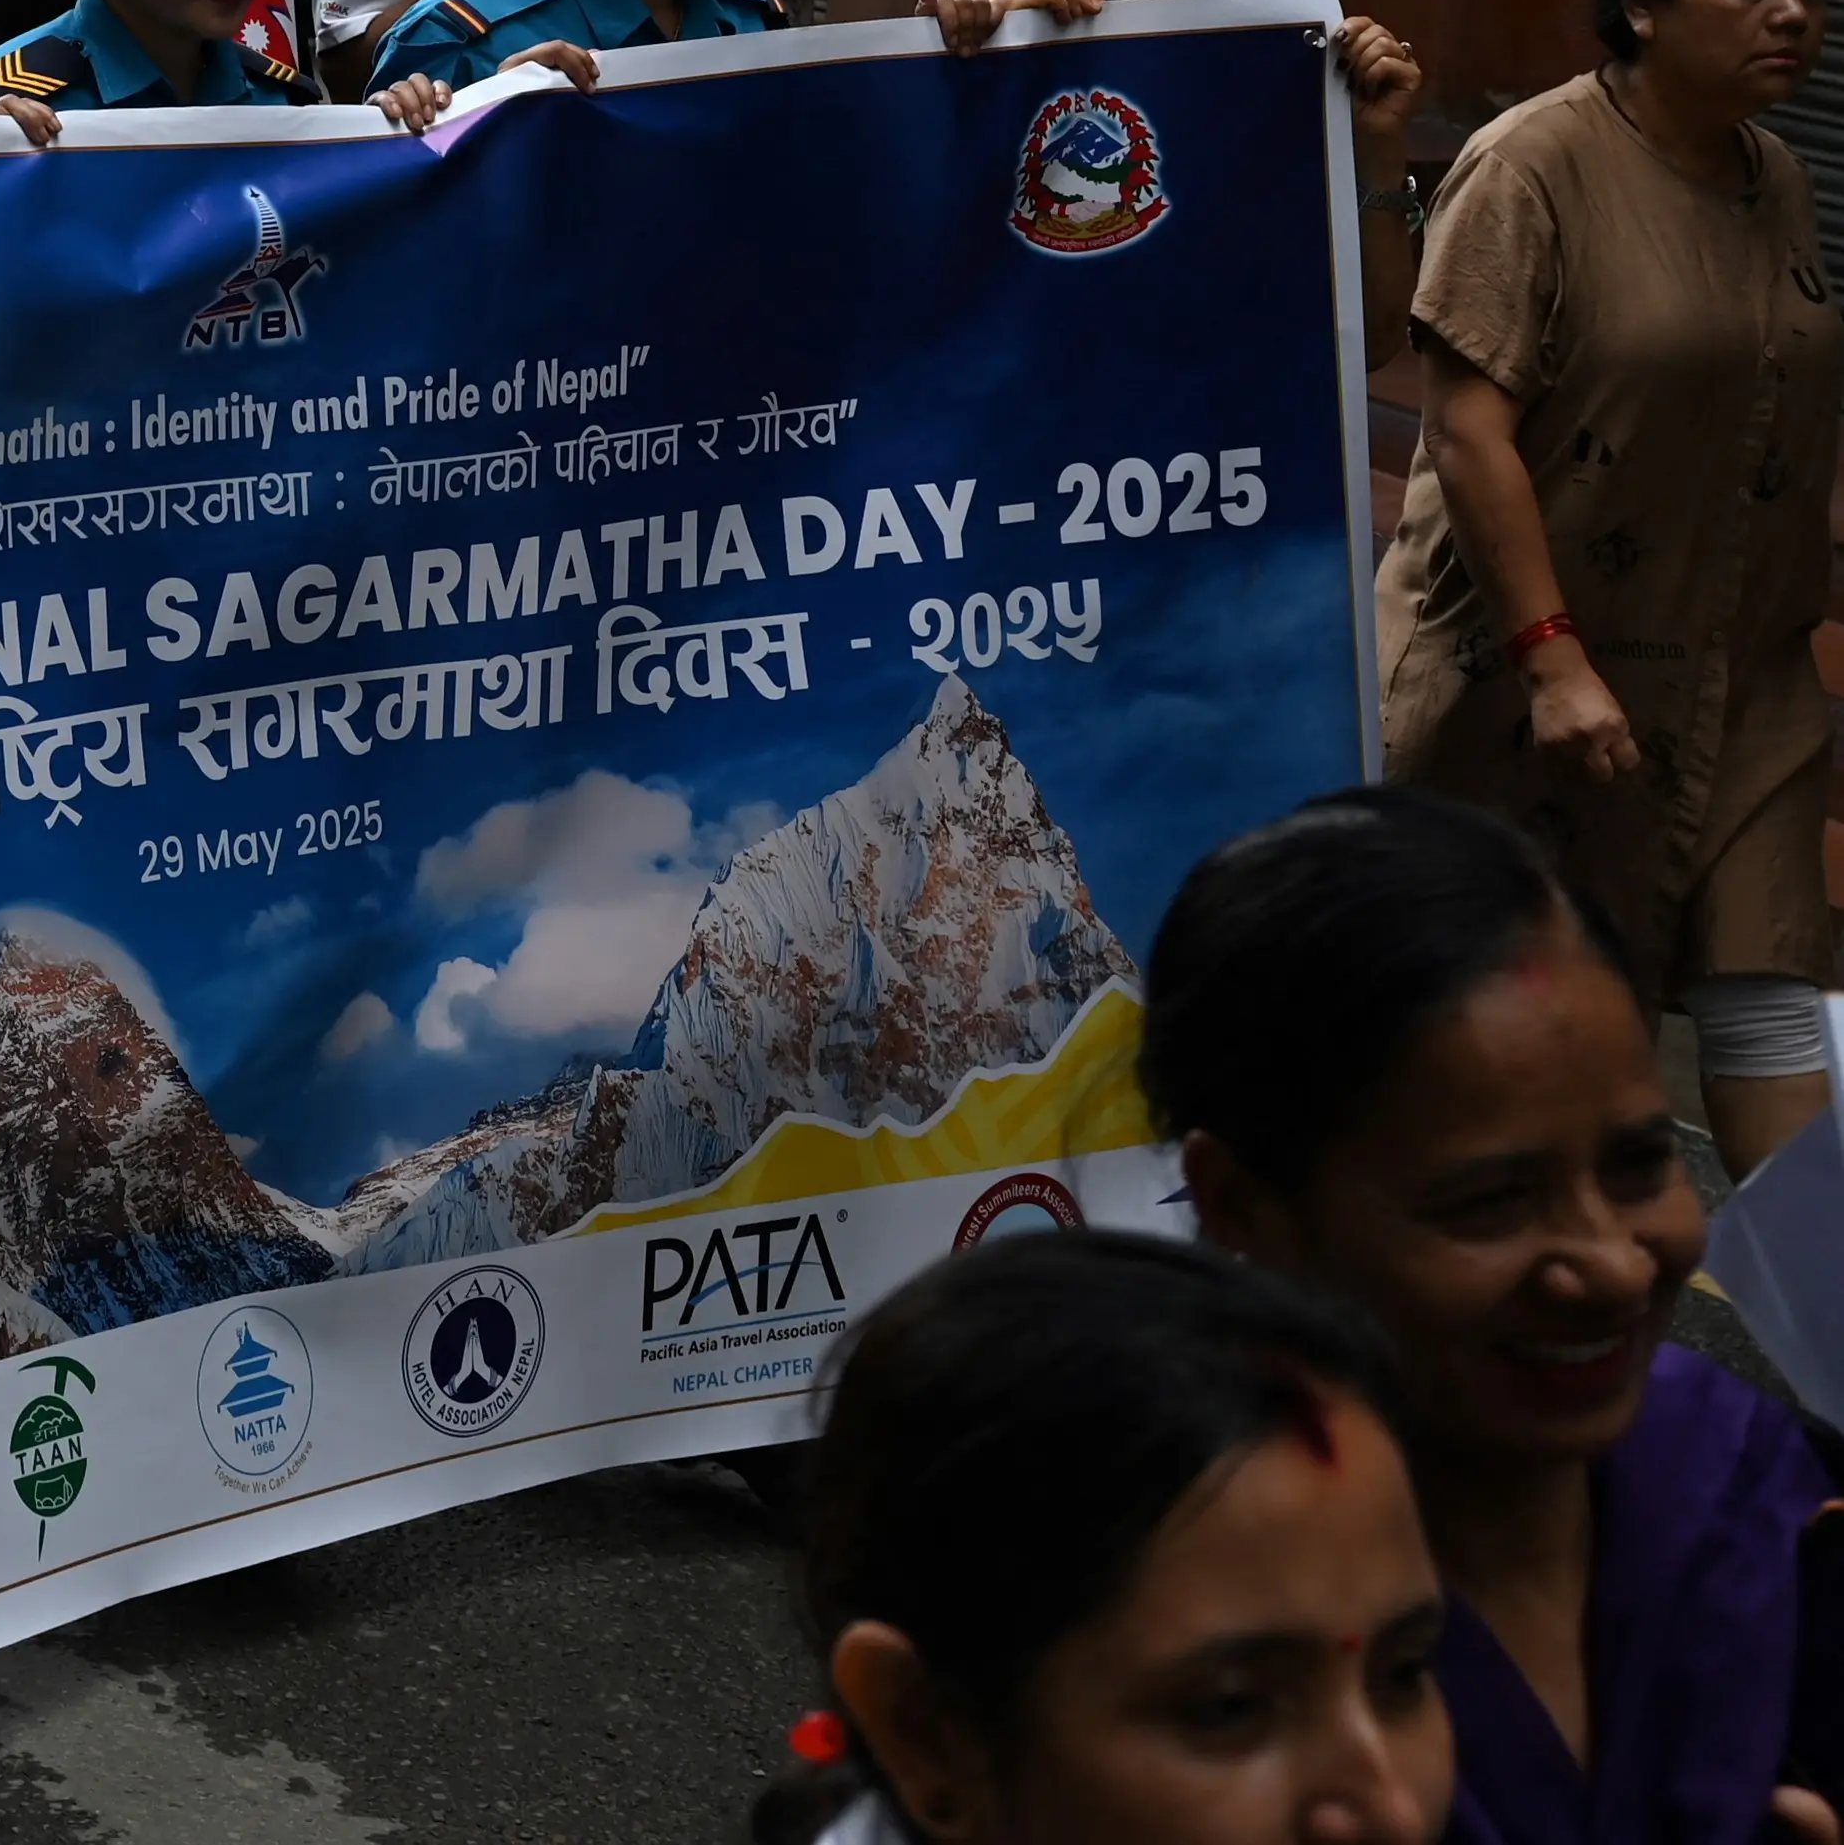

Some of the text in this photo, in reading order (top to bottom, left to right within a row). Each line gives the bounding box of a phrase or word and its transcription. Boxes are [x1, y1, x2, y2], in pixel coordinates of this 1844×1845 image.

[184, 310, 287, 348] NTB
[105, 420, 116, 453] :
[131, 393, 277, 450] Identity
[291, 376, 368, 436] and
[384, 367, 480, 428] Pride
[491, 358, 528, 414] of
[535, 344, 650, 416] Nepal”
[367, 431, 543, 510] नेपालको
[553, 423, 685, 487] पहिचान
[696, 417, 725, 462] र
[144, 501, 773, 664] SAGARMATHA
[782, 477, 979, 580] DAY
[996, 502, 1040, 526] -
[1055, 445, 1269, 546] 2025
[176, 641, 574, 776] सगरमाथा
[595, 602, 814, 715] दिवस
[908, 575, 1104, 675] २०२५
[137, 797, 386, 885] 29 May 2025
[978, 1182, 1041, 1217] Summiteers
[431, 1277, 516, 1318] HAN
[641, 1212, 847, 1333] PATA
[639, 1318, 848, 1363] Pacific Asia Travel Association
[410, 1337, 536, 1427] HOTEL ASSOCIATION NEPAL
[671, 1356, 814, 1395] NEPAL CHAPTER
[233, 1413, 289, 1445] NATTA
[249, 1438, 276, 1457] 1966
[13, 1435, 84, 1475] TAAN
[213, 1439, 314, 1495] Together We Can Achieve
